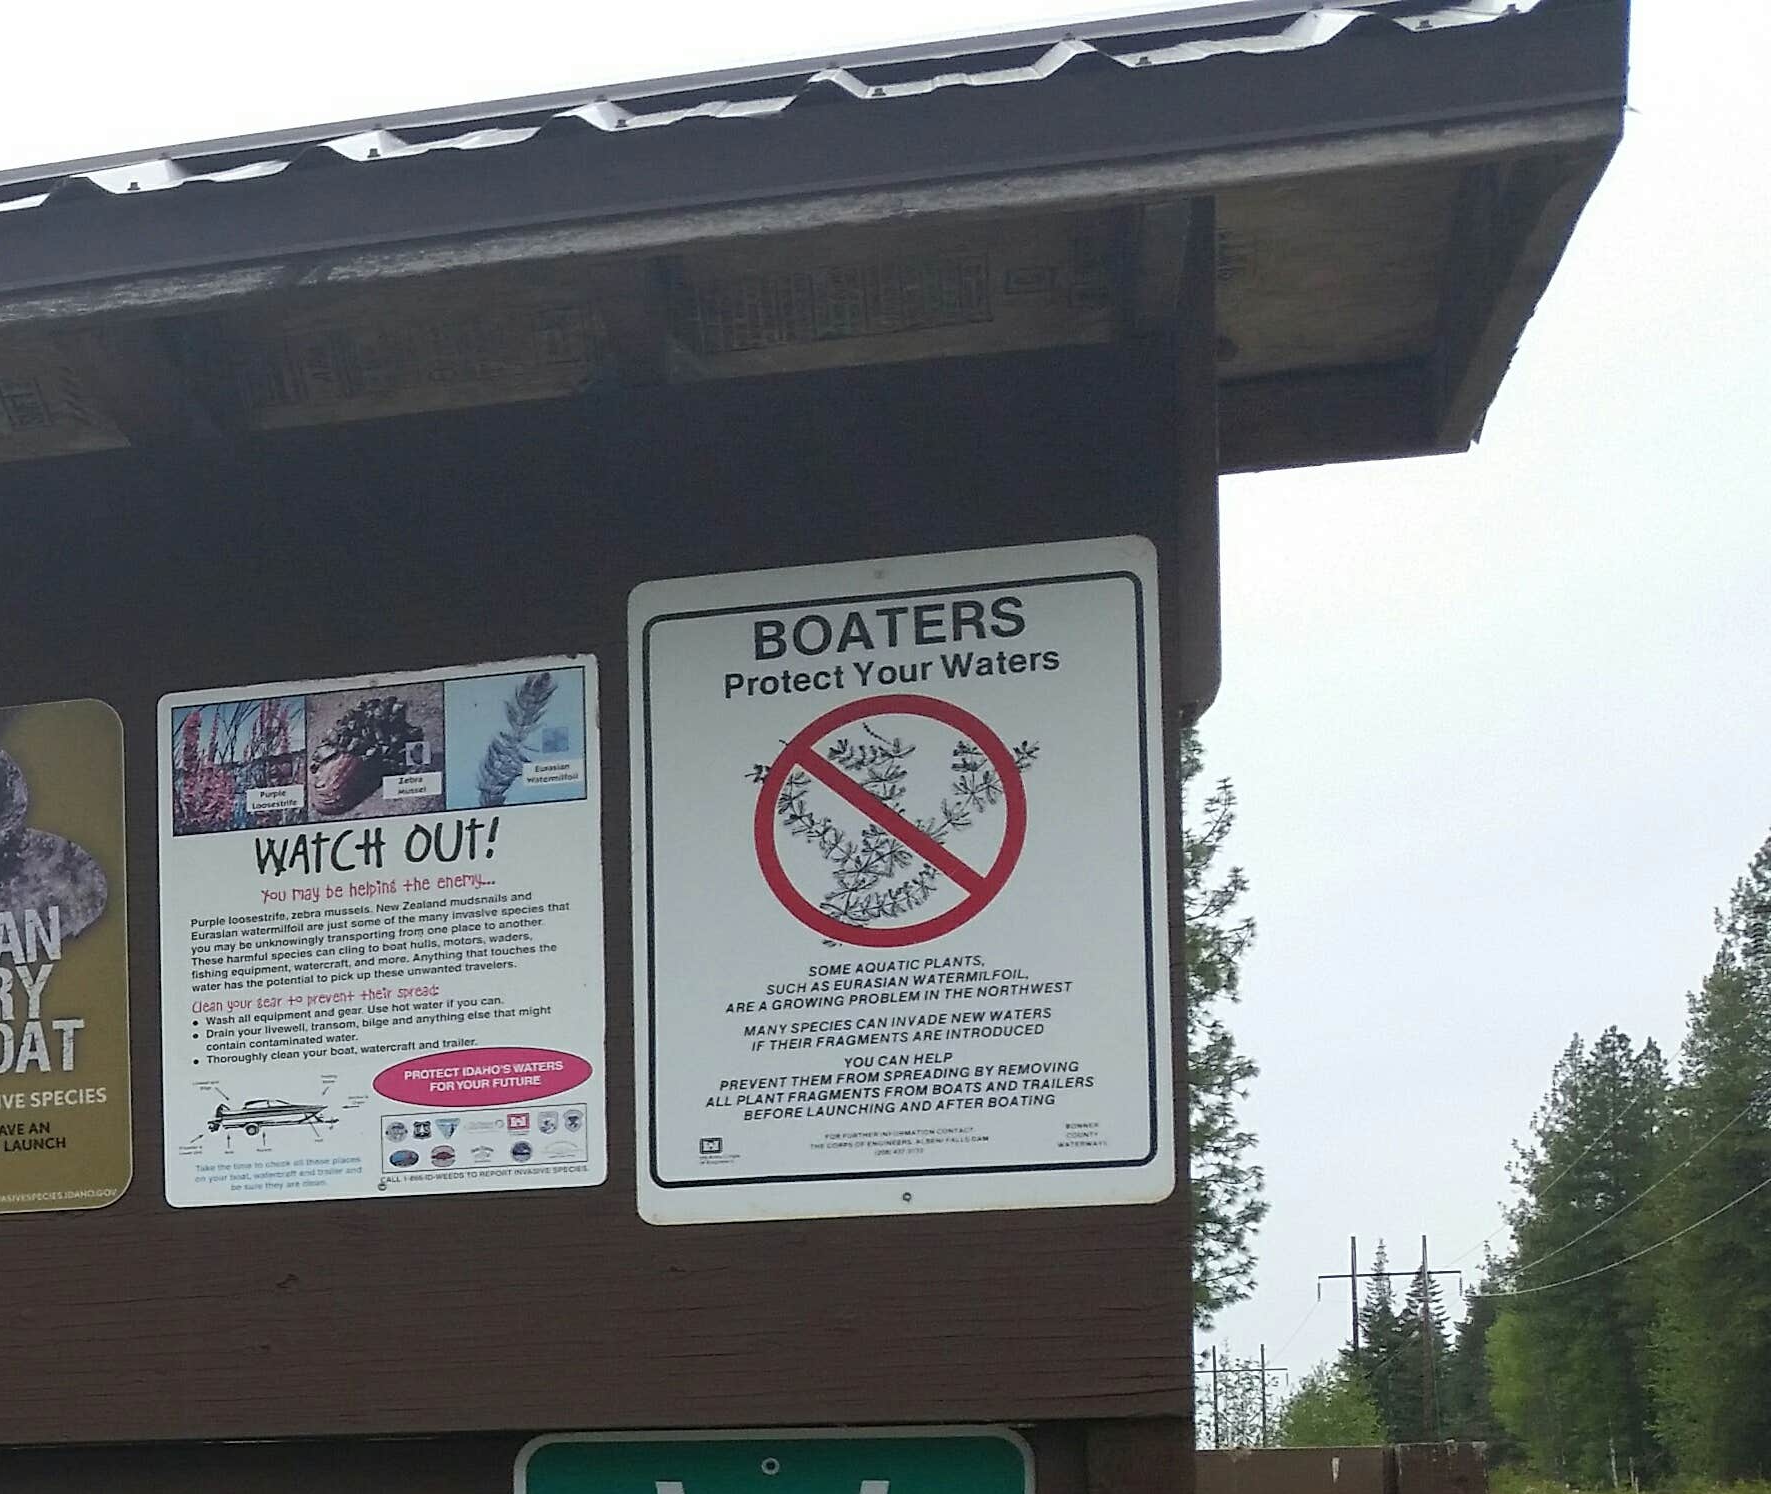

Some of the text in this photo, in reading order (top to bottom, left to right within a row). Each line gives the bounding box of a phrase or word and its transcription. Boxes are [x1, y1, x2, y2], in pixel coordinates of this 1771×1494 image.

[754, 596, 1025, 660] BOATERS
[724, 650, 1060, 699] Protect Your Waters
[255, 816, 500, 877] WATCH OUT!
[260, 889, 287, 905] you
[291, 887, 321, 902] may
[325, 884, 343, 900] be
[349, 878, 397, 898] helping
[402, 877, 431, 893] the
[191, 961, 518, 993] water has the potential to pick up these unwanted travelers.
[808, 954, 985, 977] SOME AQUATIC PLANTS,
[766, 969, 1029, 996] SUCH AS EURASIAN WATERMILFOIL,
[725, 981, 1073, 1014] ARE A GROWING PROBLEM IN THE NORTHWEST
[743, 1007, 1052, 1037] MANY SPECIES CAN INVADE NEW WATERS
[751, 1024, 1044, 1052] IF THEIR FRAGMENTS ARE INTRODUCED
[404, 1061, 563, 1080] PROTECT IDAHO'S WATERS
[844, 1052, 953, 1069] YOU CAN HELP
[430, 1076, 541, 1092] FOR YOUR FUTURE
[719, 1060, 1079, 1092] PREVENT THEM FROM SPREADING BY REMOVING
[30, 1088, 107, 1107] SPECIES
[705, 1075, 1095, 1108] ALL PLANT FRAGMENTS FROM BOATS AND TRAILERS
[743, 1094, 1055, 1121] BEFORE LAUNCHING AND AFTER BOATING
[28, 1121, 51, 1135] AN
[4, 1136, 67, 1153] LAUNCH
